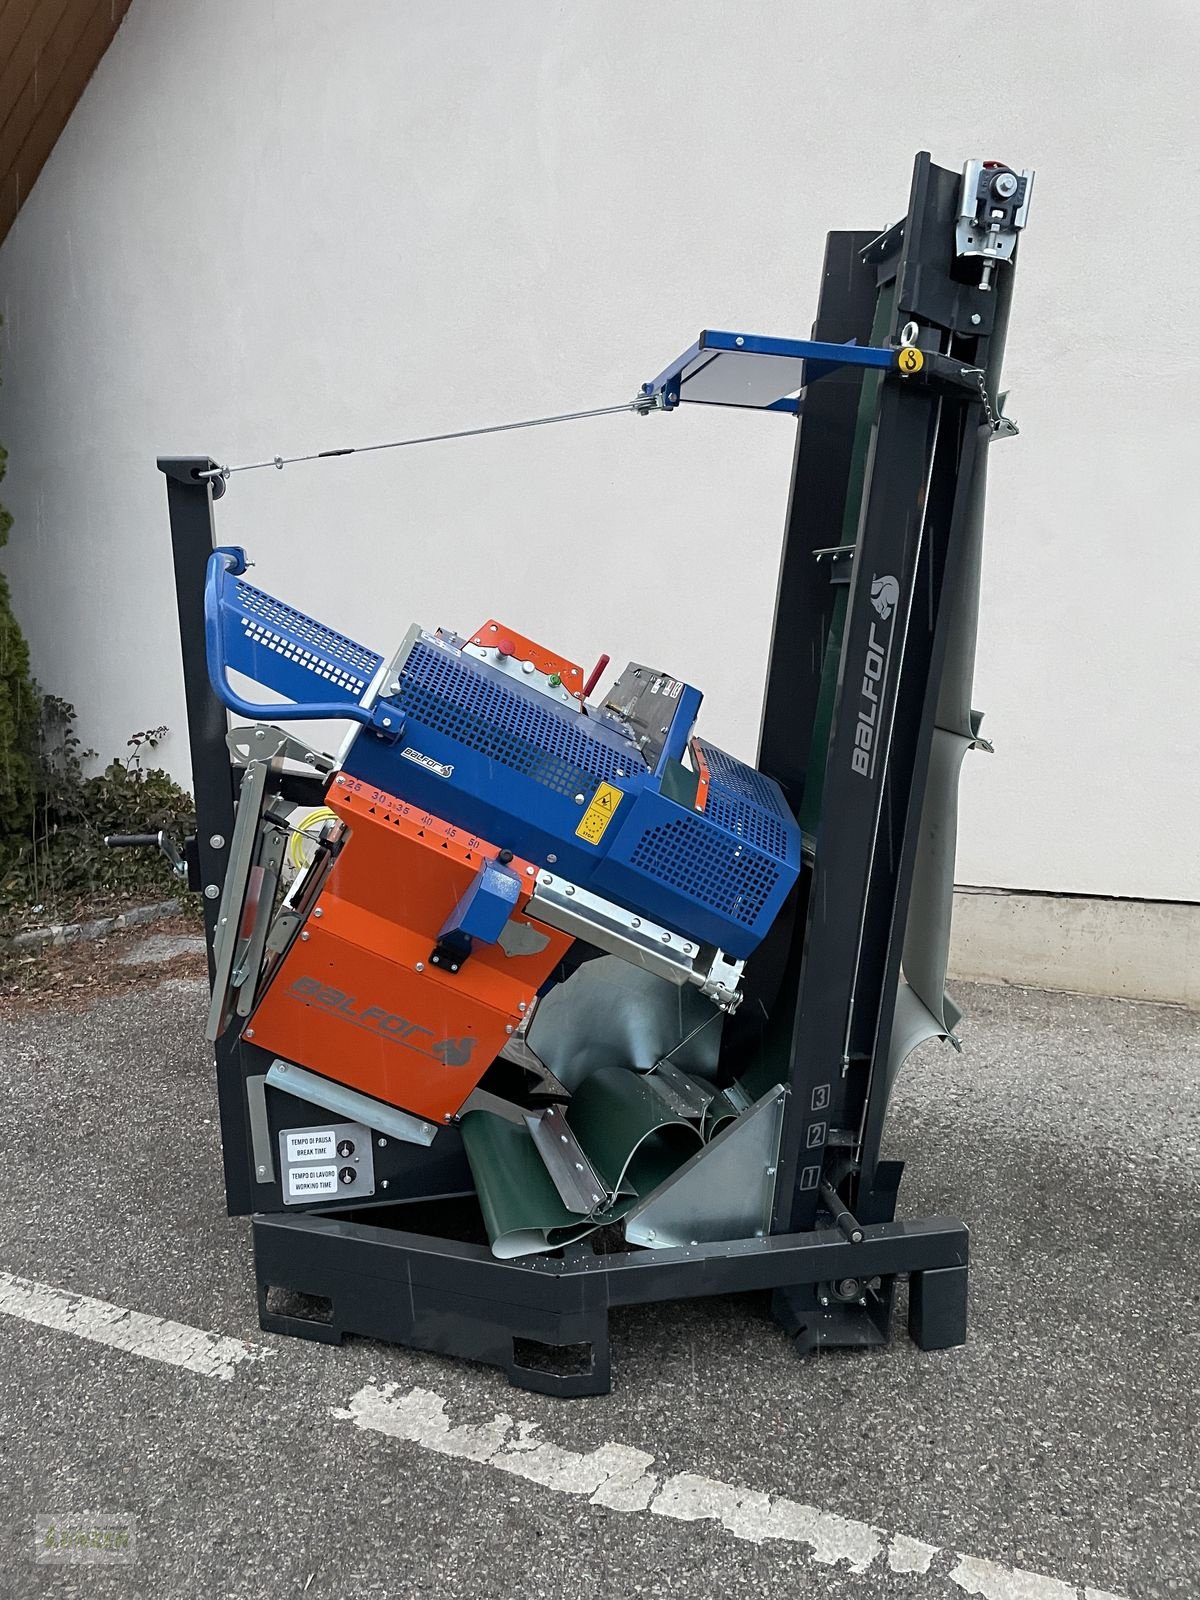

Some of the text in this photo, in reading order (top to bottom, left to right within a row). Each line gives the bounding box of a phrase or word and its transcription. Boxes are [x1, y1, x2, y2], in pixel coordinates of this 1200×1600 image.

[346, 779, 363, 792] 25
[371, 791, 386, 804] 30
[396, 803, 410, 815] 35
[421, 815, 433, 826] 40
[445, 827, 457, 838] 45
[468, 838, 480, 849] 50
[815, 1088, 826, 1107] 3
[811, 1126, 822, 1145] 2
[291, 1138, 308, 1146] TEMPO
[292, 1172, 309, 1180] TEMPO
[807, 1169, 815, 1187] 1
